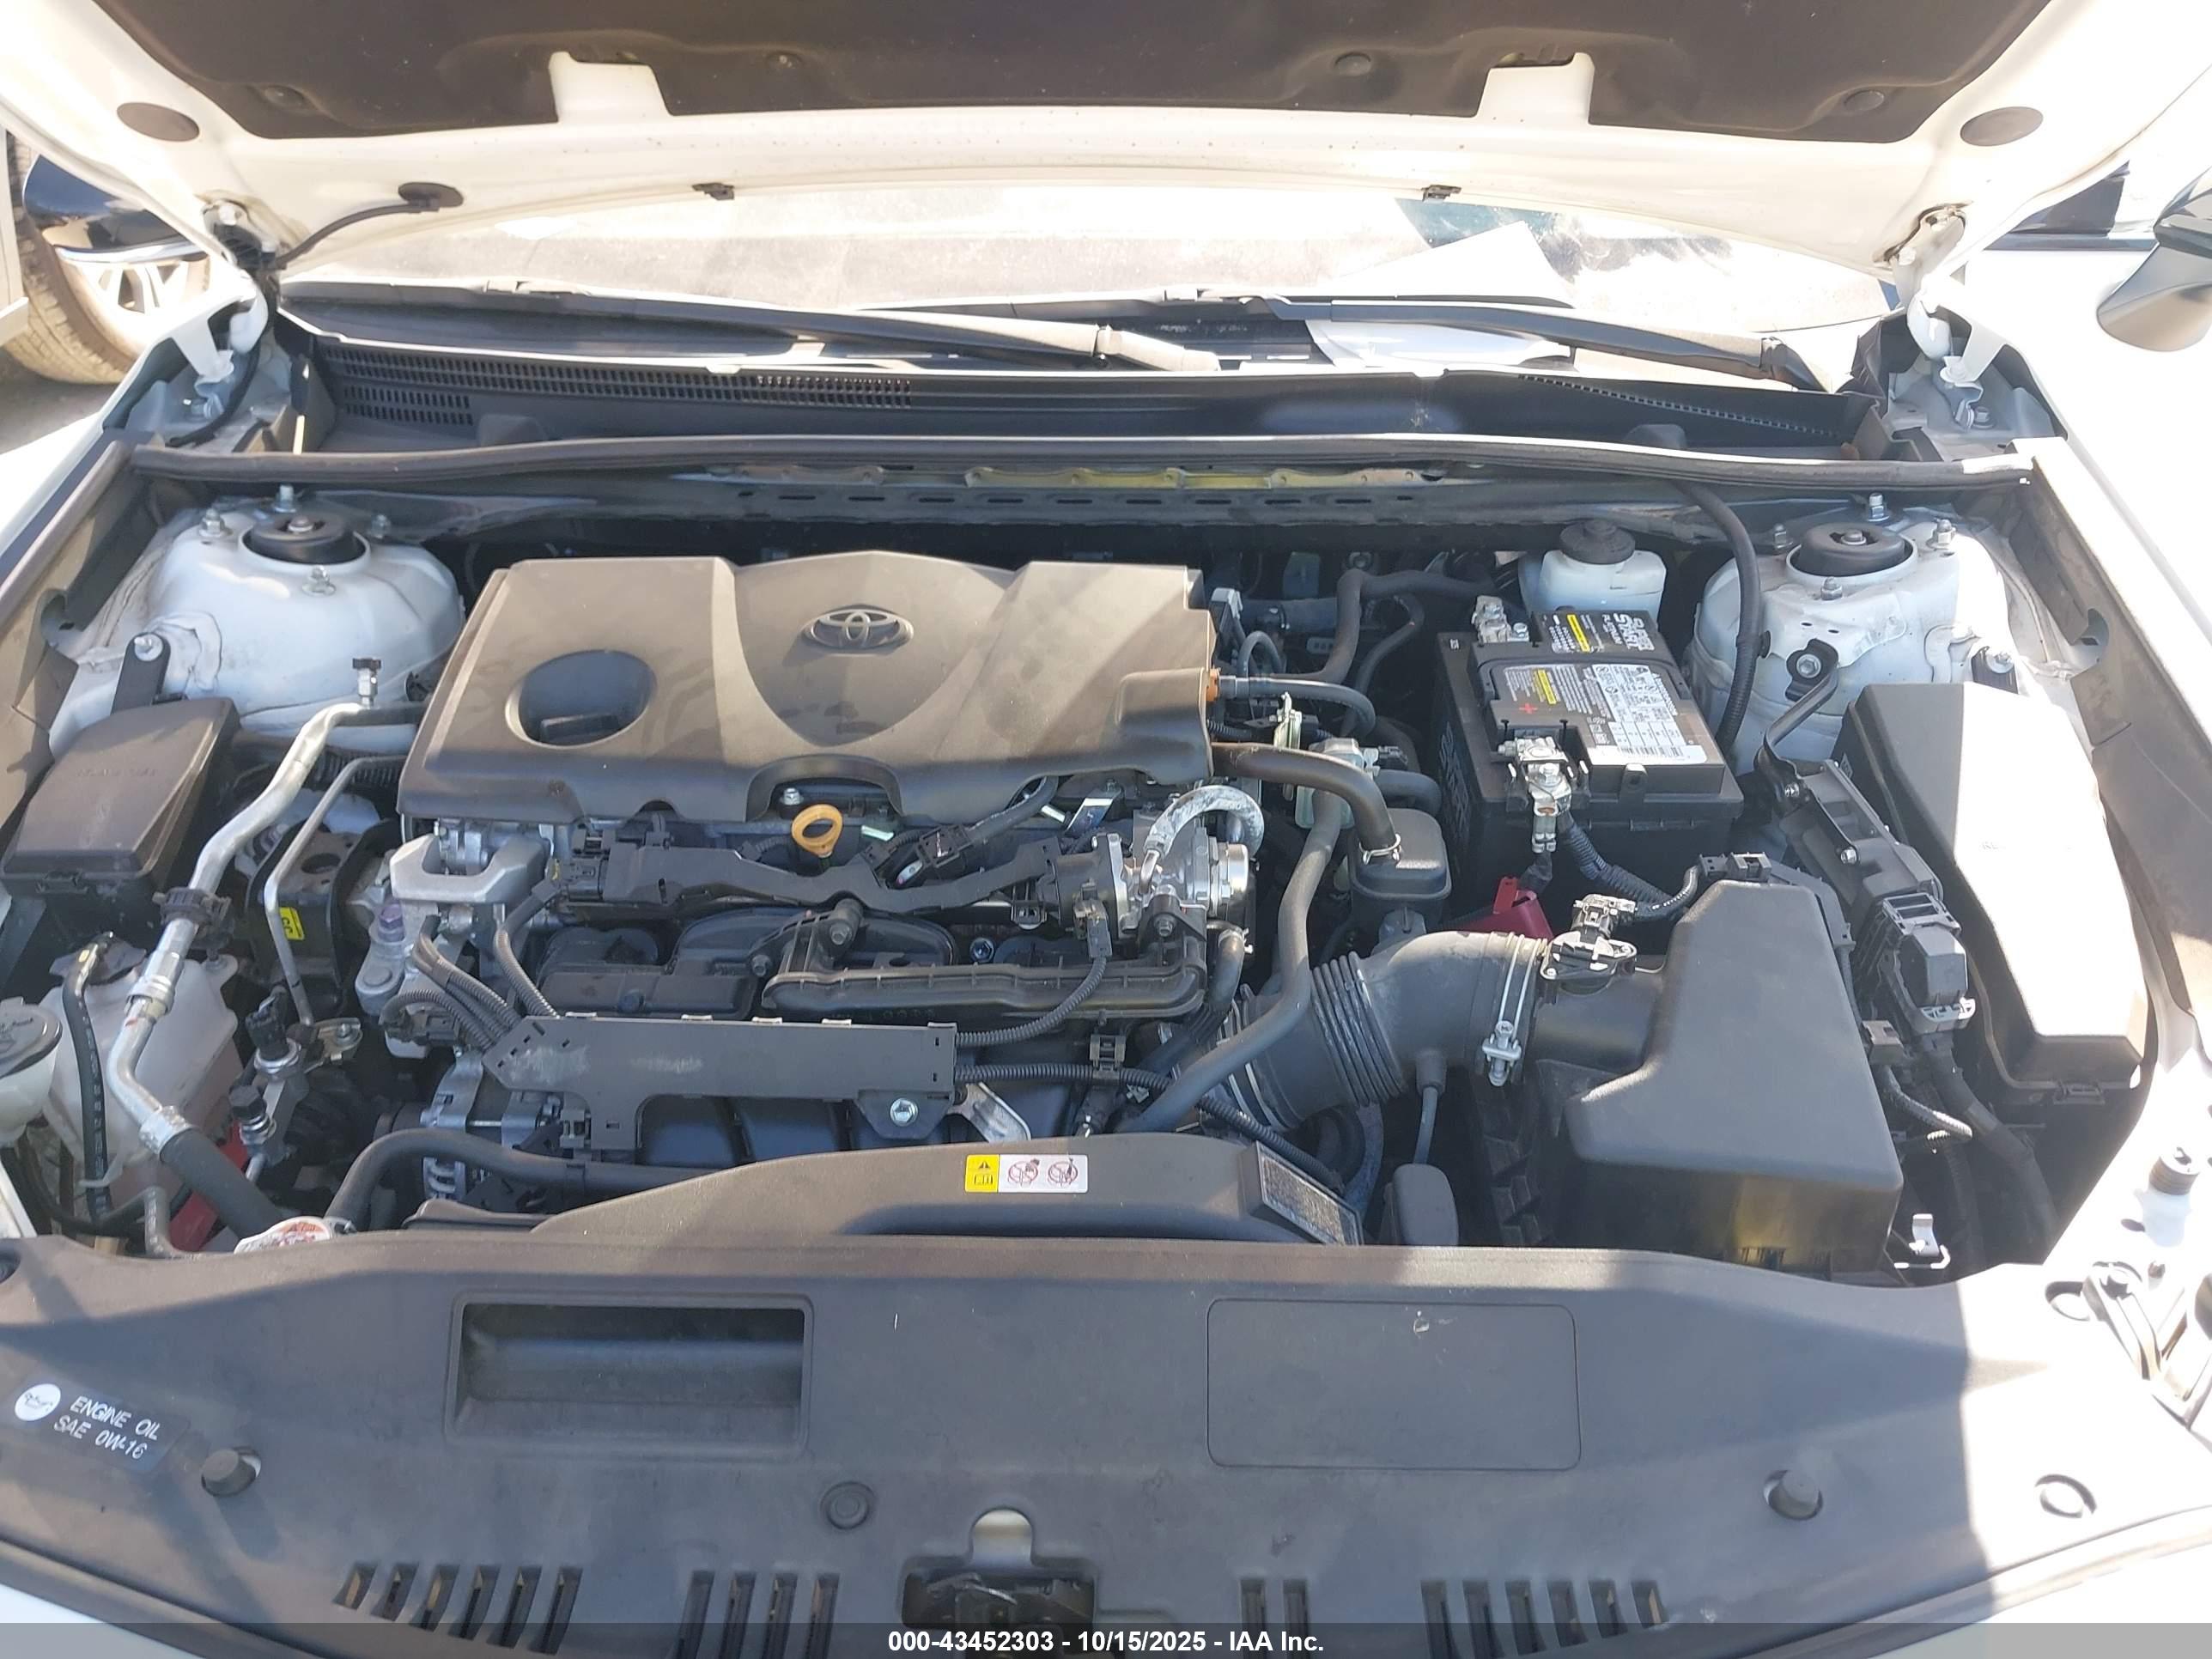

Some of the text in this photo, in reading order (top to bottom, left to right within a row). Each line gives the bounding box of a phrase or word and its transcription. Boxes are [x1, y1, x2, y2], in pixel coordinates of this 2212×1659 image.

[54, 1415, 147, 1459] SAE 0W-16
[70, 1396, 160, 1440] ENGINE OIL
